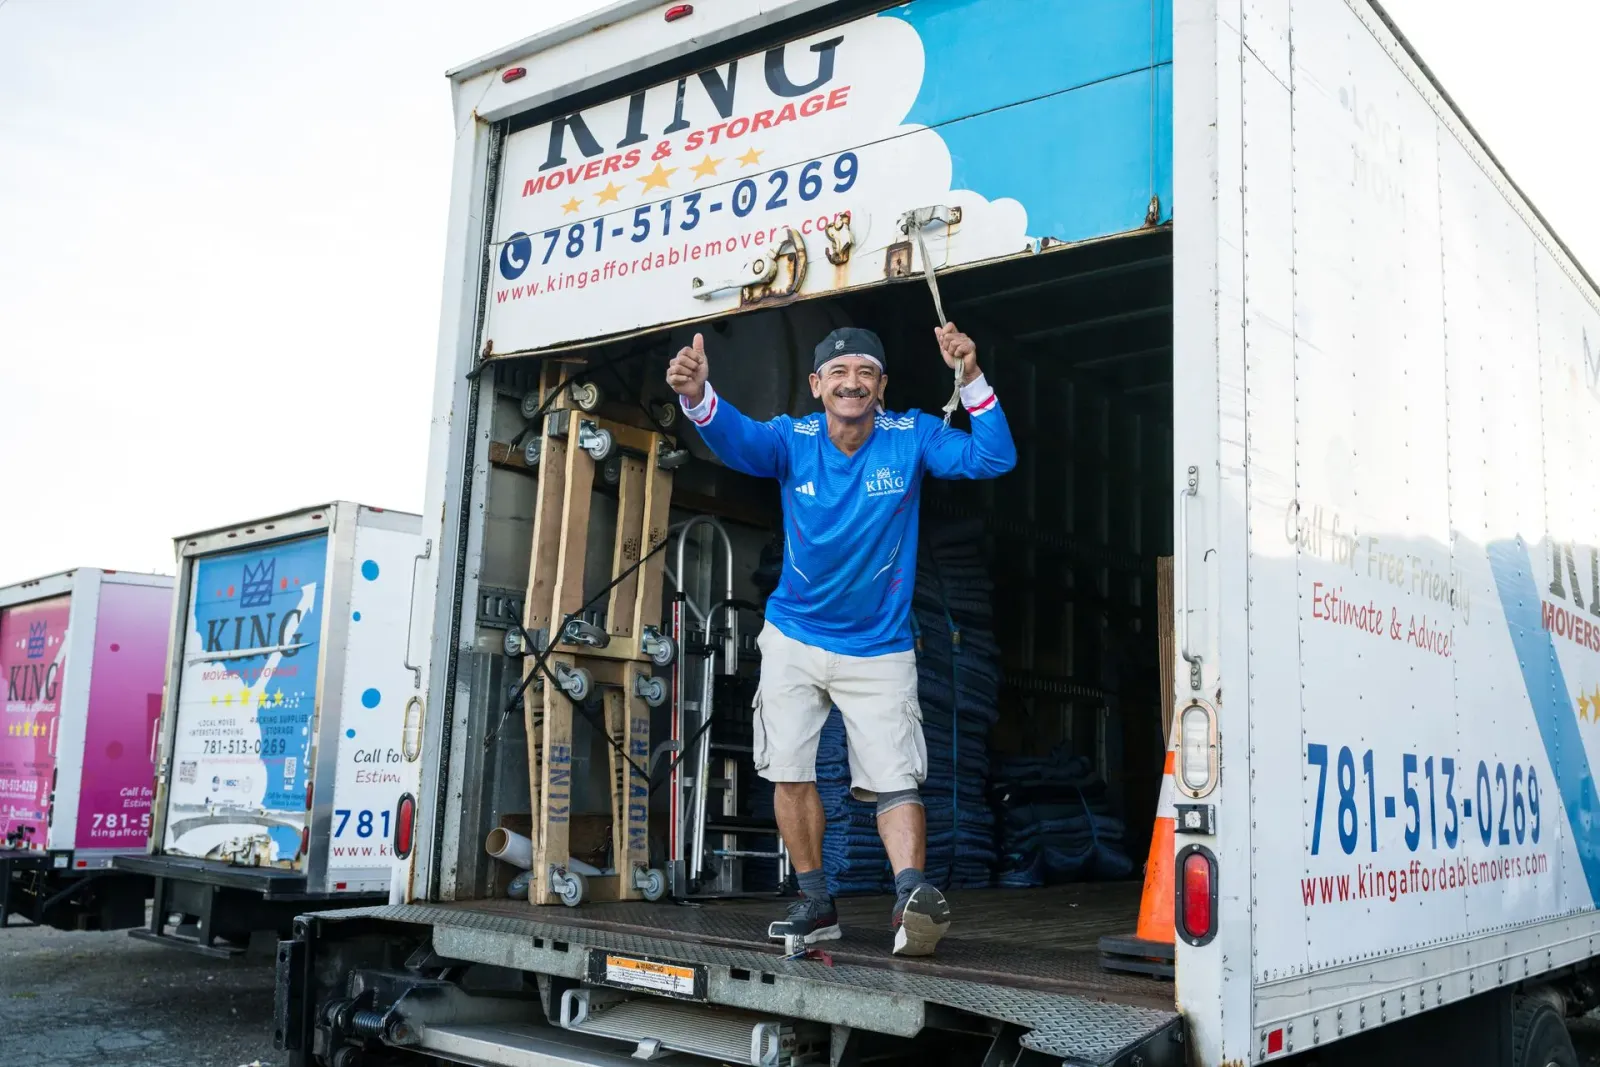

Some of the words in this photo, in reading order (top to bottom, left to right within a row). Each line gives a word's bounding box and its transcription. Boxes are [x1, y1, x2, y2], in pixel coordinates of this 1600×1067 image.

[538, 36, 845, 172] KING
[522, 149, 641, 197] MOVERS
[651, 141, 673, 162] &
[684, 86, 851, 154] STORAGE
[541, 152, 859, 264] 781-513-0269
[496, 210, 852, 304] www.kingaffordablemoverco
[866, 476, 904, 492] KING
[1284, 498, 1323, 557] Call
[1331, 511, 1359, 571] for
[1367, 536, 1405, 588] Free
[1411, 555, 1471, 626] Friendly
[207, 609, 303, 662] KING
[1312, 581, 1384, 637] Estimate
[1389, 605, 1403, 641] &
[1407, 613, 1454, 658] Advice!
[1541, 600, 1600, 653] MOVERS
[7, 663, 58, 701] KING
[353, 749, 381, 763] Call
[120, 787, 139, 796] Call
[549, 745, 571, 823] KING
[1307, 743, 1541, 856] 781-513-0269
[93, 814, 150, 828] 781-5
[334, 810, 390, 838] 781
[1301, 852, 1548, 907] www.kingaffordablemovers.com
